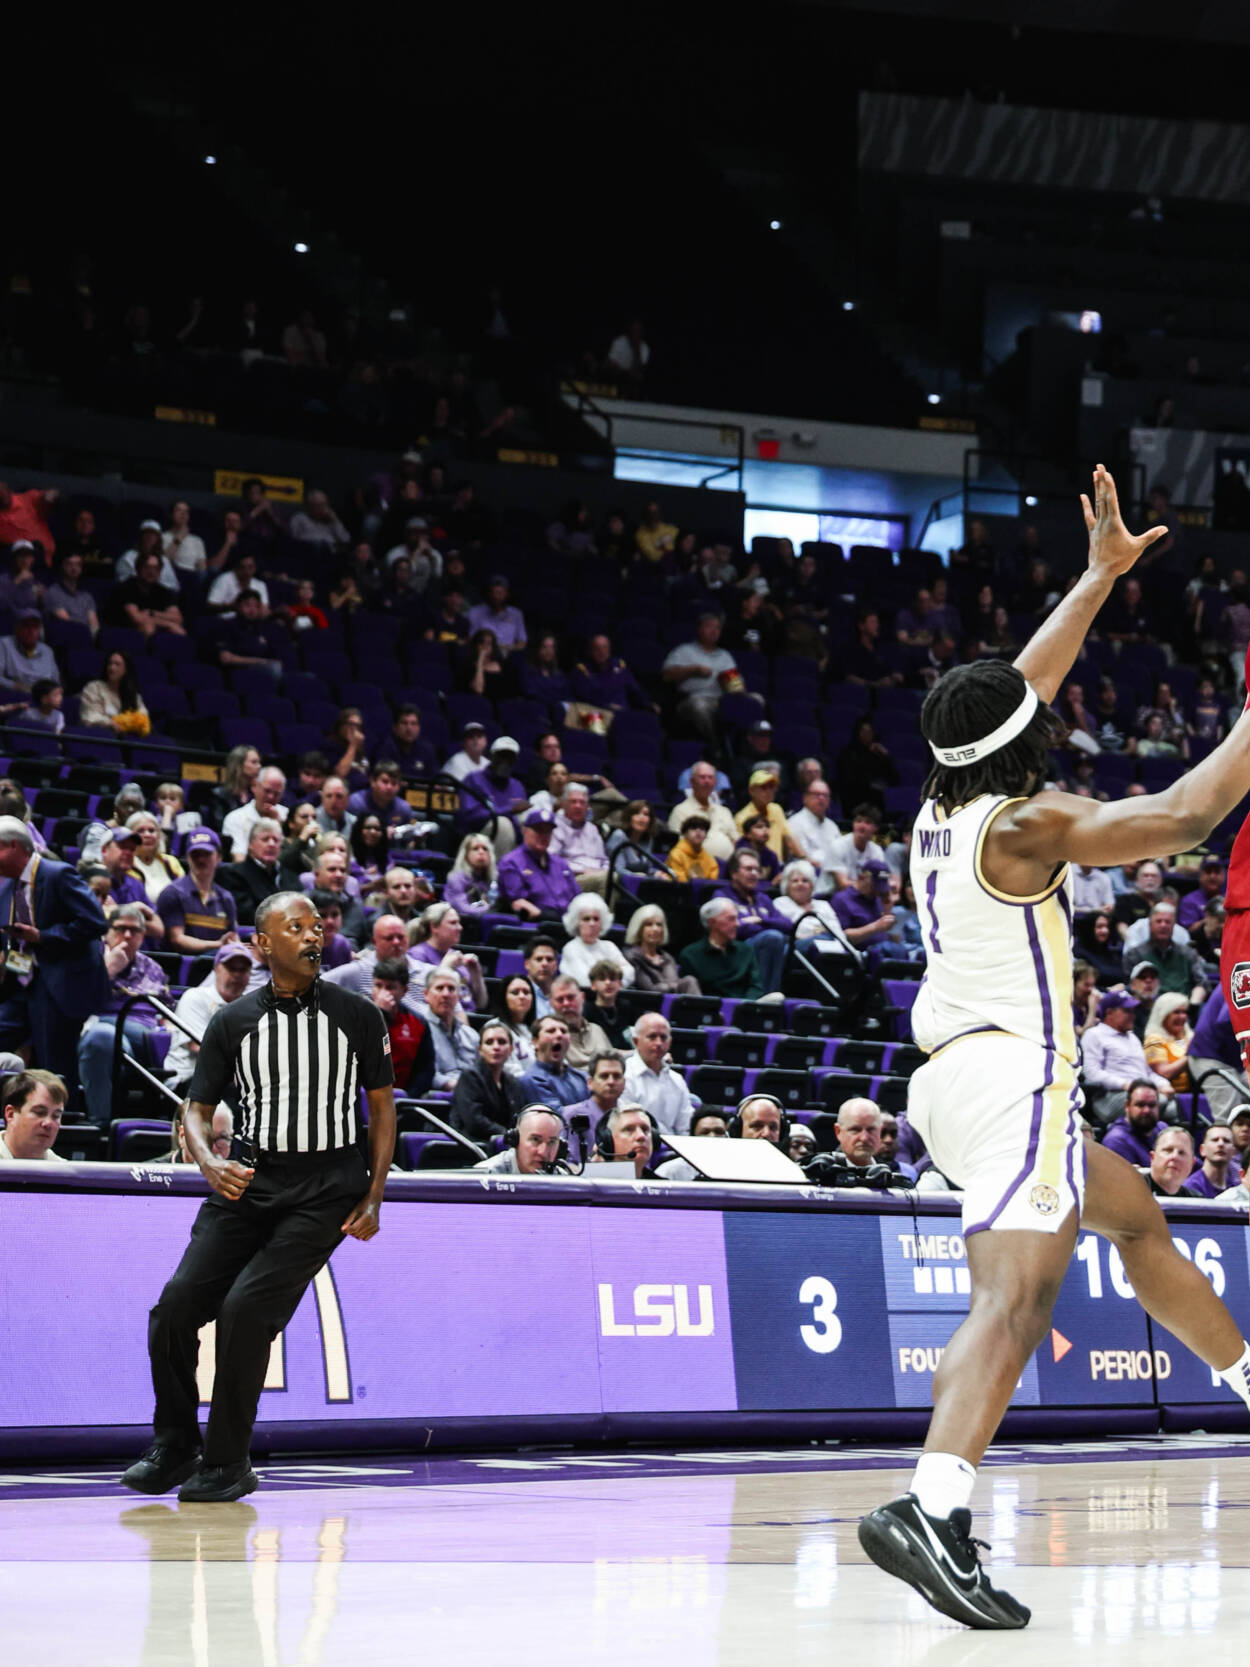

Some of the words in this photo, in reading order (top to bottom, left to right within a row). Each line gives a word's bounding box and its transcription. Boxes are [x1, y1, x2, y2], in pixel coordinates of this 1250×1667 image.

[926, 870, 943, 953] 1
[898, 1234, 968, 1260] TIMEO
[598, 1283, 715, 1337] LSU
[798, 1275, 843, 1354] 3
[898, 1347, 944, 1373] FOU
[1090, 1350, 1172, 1382] PERIOD
